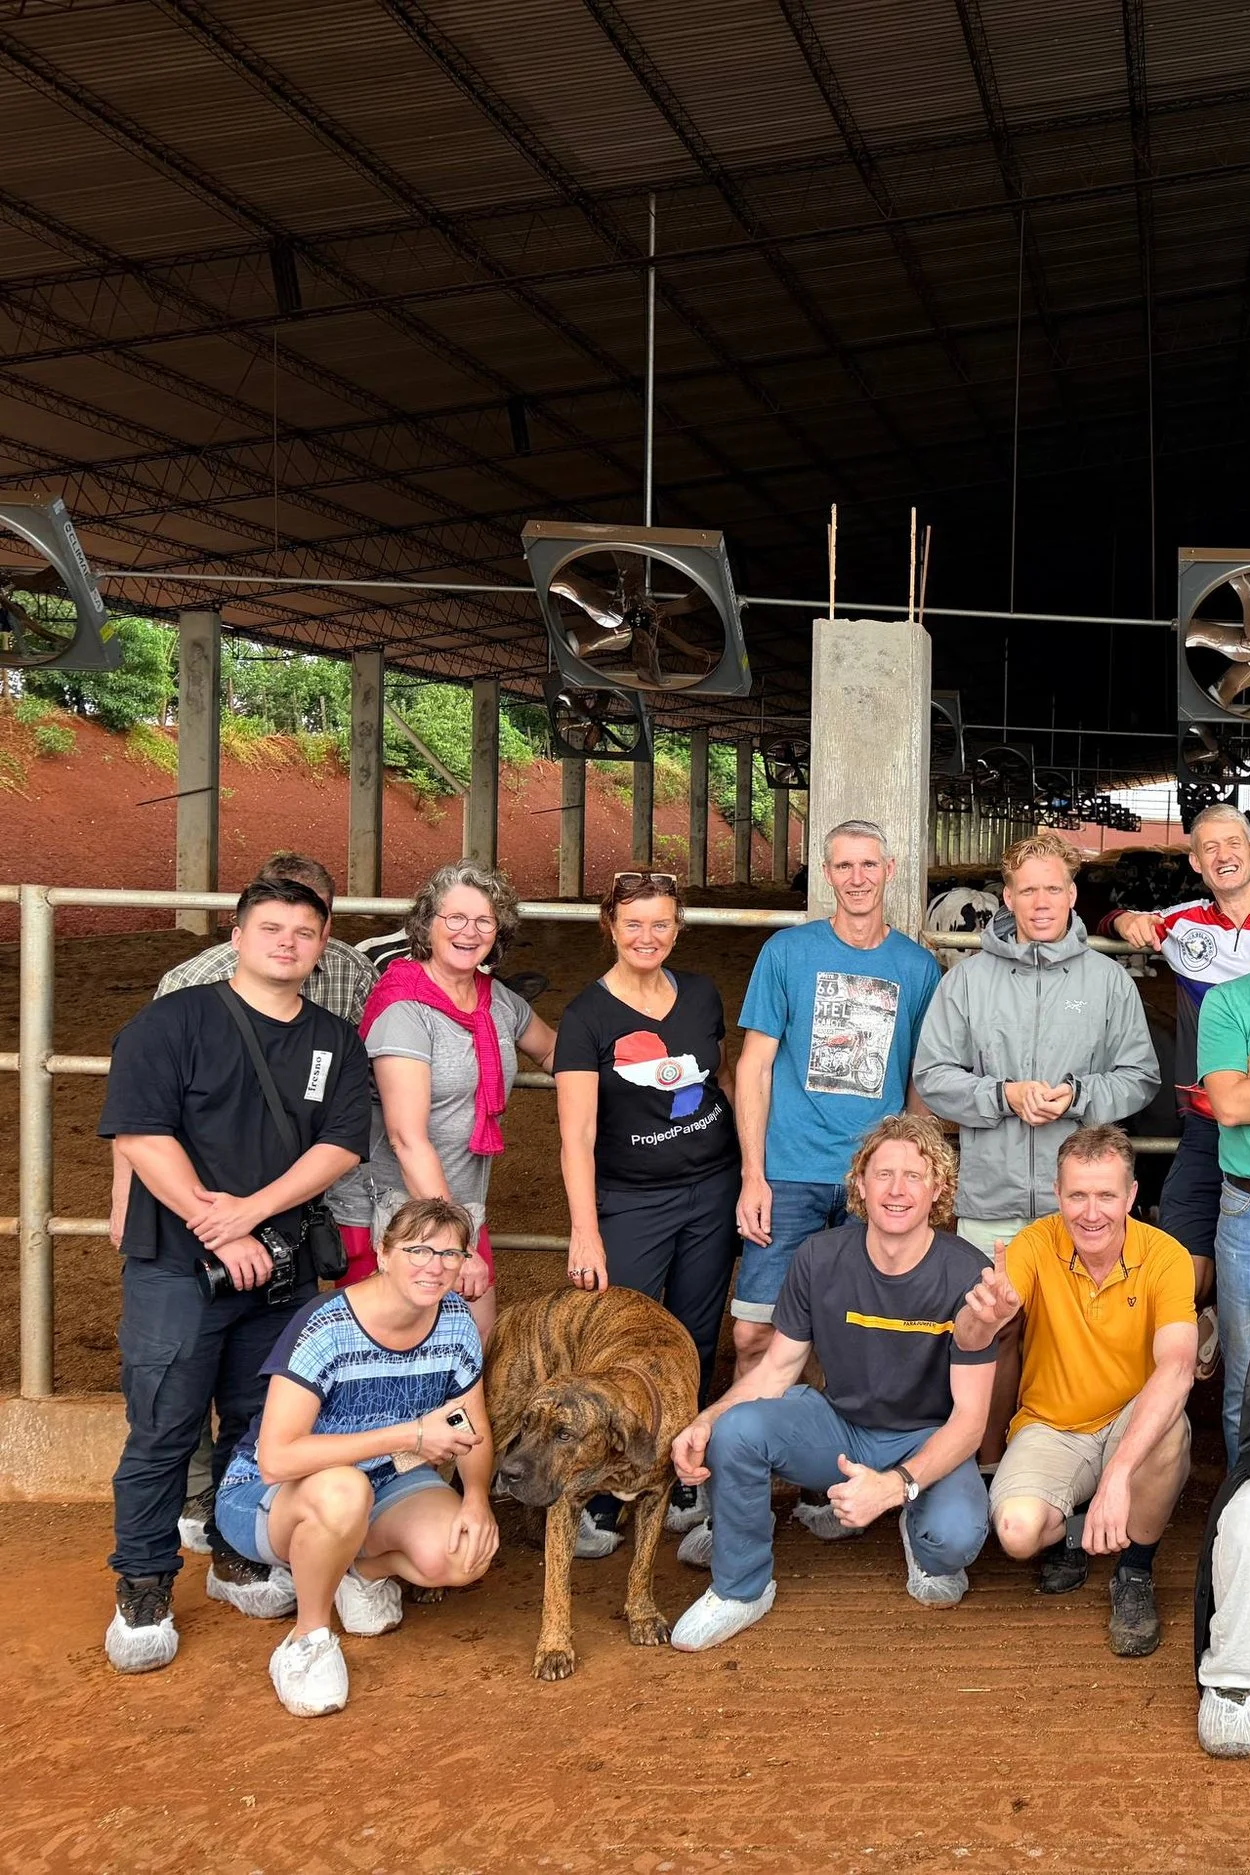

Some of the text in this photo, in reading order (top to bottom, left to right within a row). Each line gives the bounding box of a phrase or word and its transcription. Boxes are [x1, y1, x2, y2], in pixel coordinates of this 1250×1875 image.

[816, 981, 836, 995] 66
[308, 1056, 322, 1092] fresno
[630, 1103, 723, 1146] ProjectParaguay.nl
